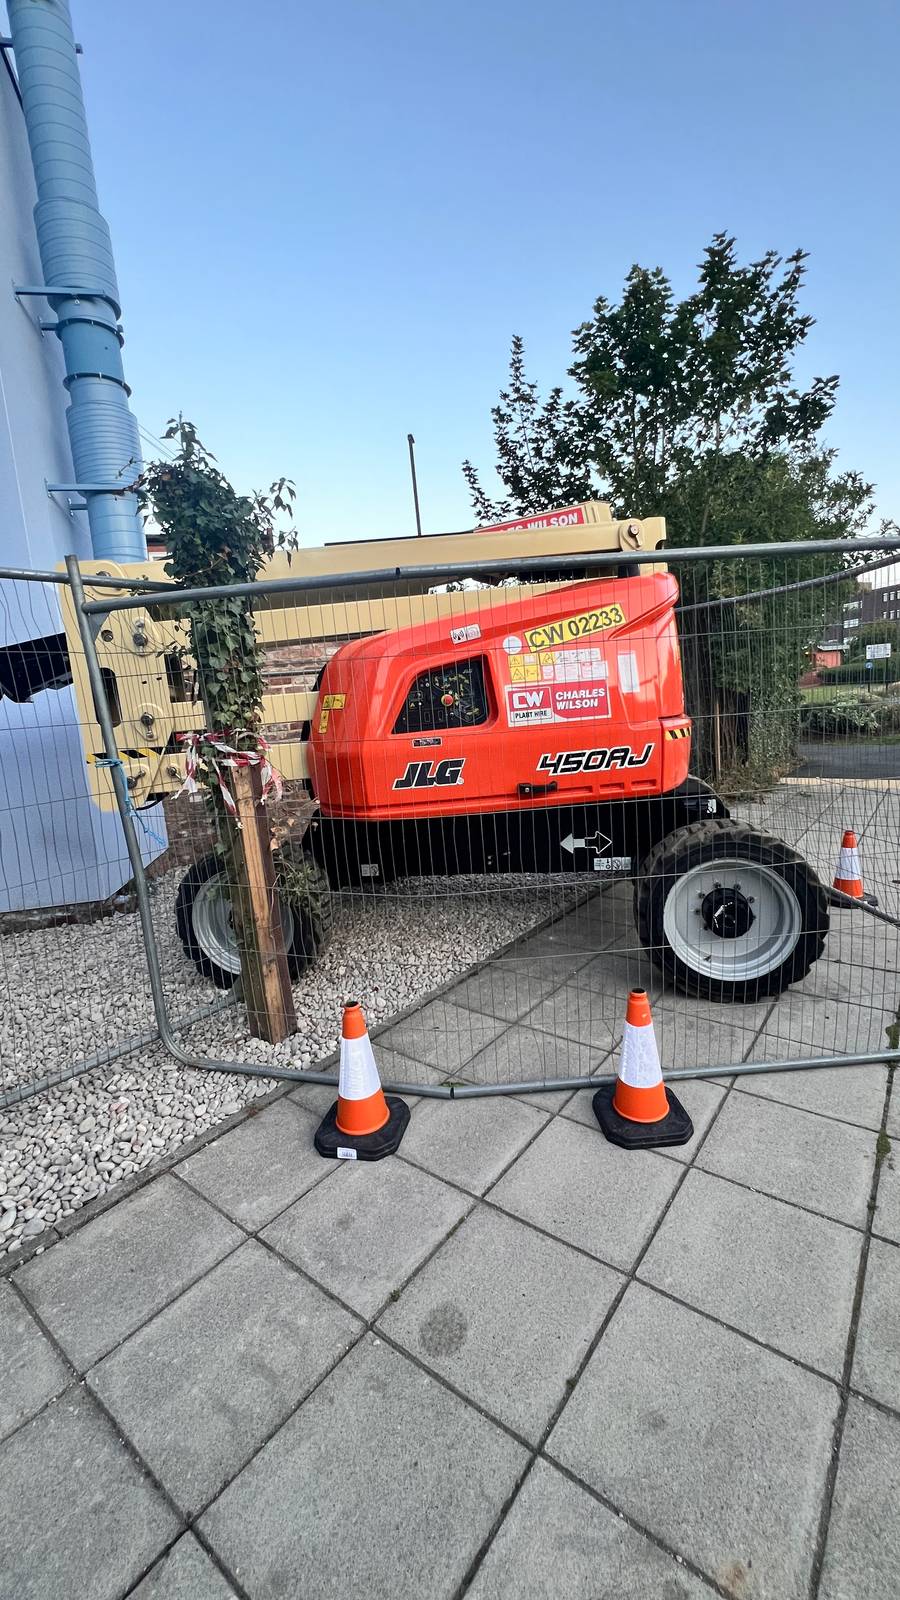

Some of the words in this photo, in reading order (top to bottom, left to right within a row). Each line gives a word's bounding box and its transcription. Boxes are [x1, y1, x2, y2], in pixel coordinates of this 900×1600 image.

[527, 512, 578, 530] WILSON
[529, 624, 564, 648] CW
[567, 607, 623, 637] 02233
[512, 691, 544, 709] CW
[555, 688, 605, 701] CHARLES
[556, 698, 599, 711] WILSON
[537, 743, 655, 776] 450AJ
[392, 758, 466, 790] JLG
